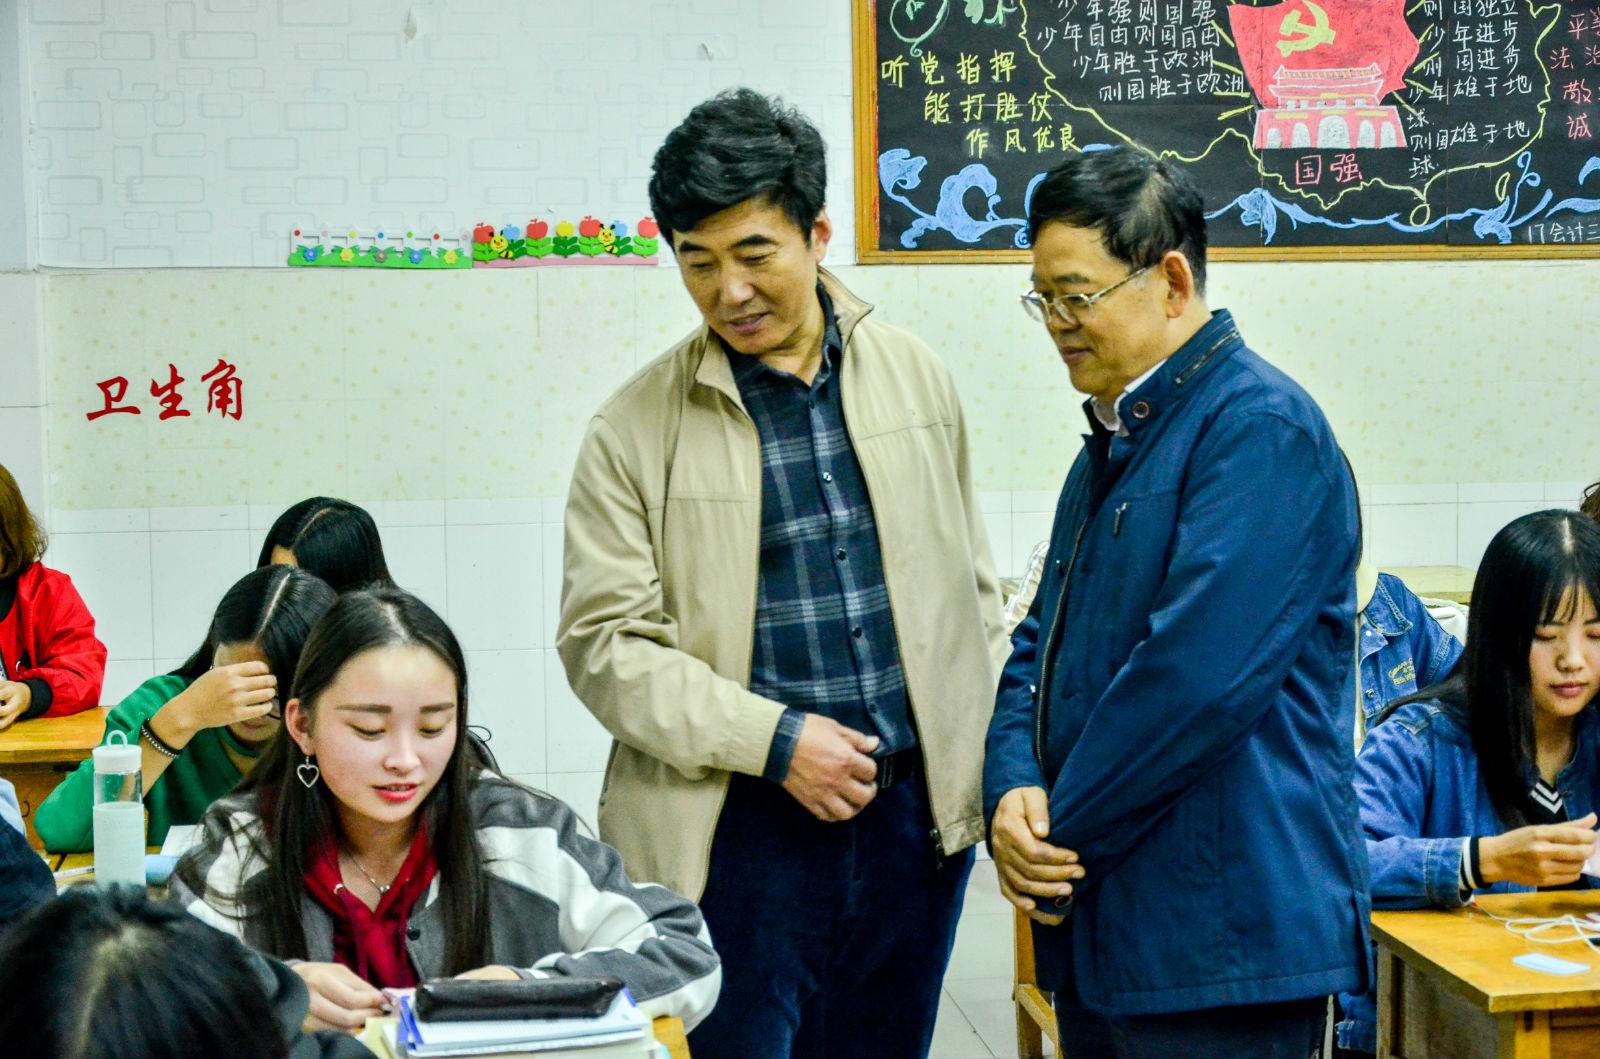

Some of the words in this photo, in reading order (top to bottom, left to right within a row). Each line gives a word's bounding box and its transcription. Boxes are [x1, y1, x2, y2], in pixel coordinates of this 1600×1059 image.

[1058, 0, 1216, 28] 少年强则国强
[1423, 0, 1519, 20] 则国独立
[1037, 21, 1220, 52] 少年自由则国自由
[1427, 19, 1518, 52] 少年进步
[881, 49, 1017, 88] 听党指挥
[1073, 48, 1213, 78] 少年胜于欧洲
[1422, 45, 1520, 77] 则国进步
[1100, 70, 1244, 101] 则国胜于欧洲
[1409, 74, 1532, 104] 少年雄于地
[924, 90, 1053, 124] 能打胜仗
[966, 124, 1082, 159] 作风优良
[1410, 120, 1530, 152] 则国雄于地
[1295, 153, 1363, 185] 国强
[86, 359, 242, 421] 卫生角
